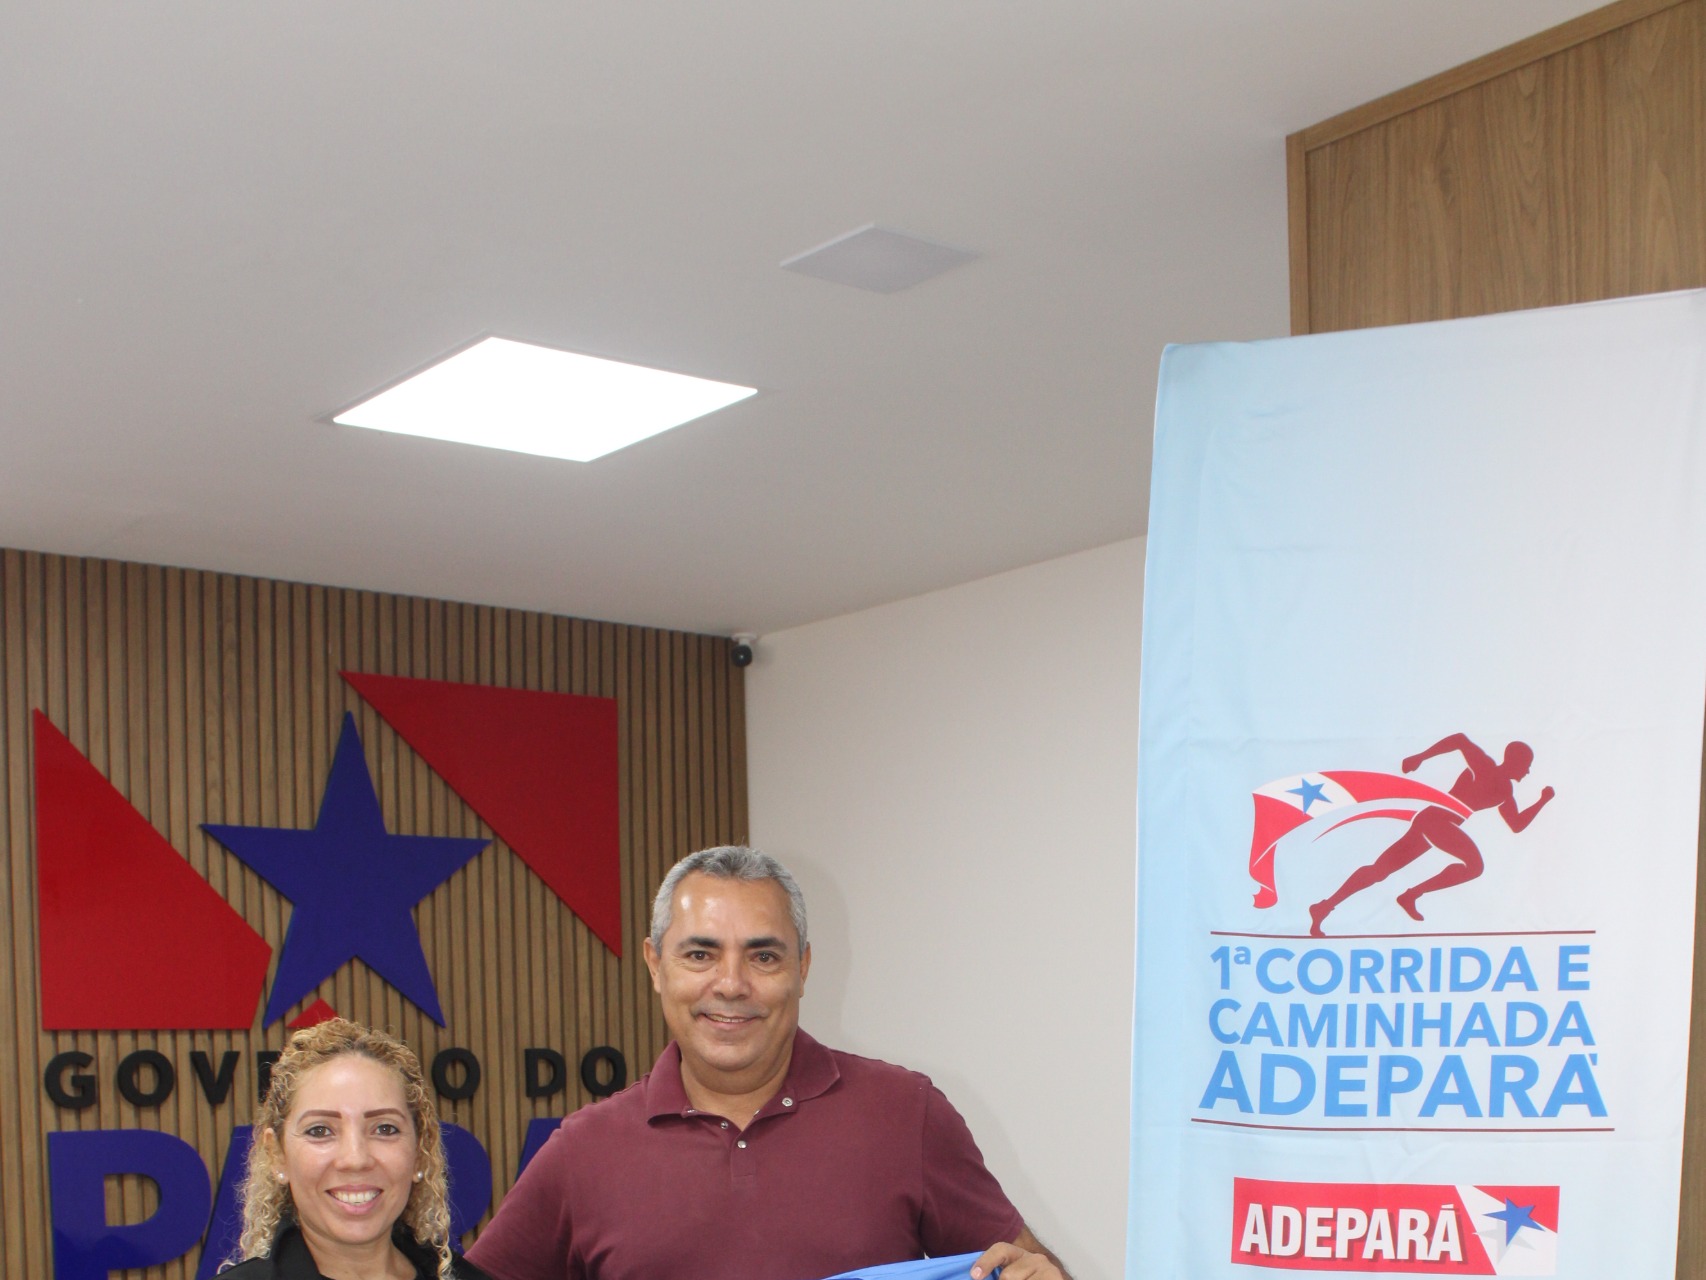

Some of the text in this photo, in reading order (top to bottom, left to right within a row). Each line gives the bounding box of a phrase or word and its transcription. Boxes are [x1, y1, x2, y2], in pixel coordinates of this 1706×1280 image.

[1557, 945, 1591, 991] E
[1208, 998, 1596, 1049] CAMINHADA
[44, 1045, 627, 1110] GOVO DO
[1198, 1050, 1608, 1118] ADEPARÁ
[1239, 1202, 1464, 1262] ADEPARÁ
